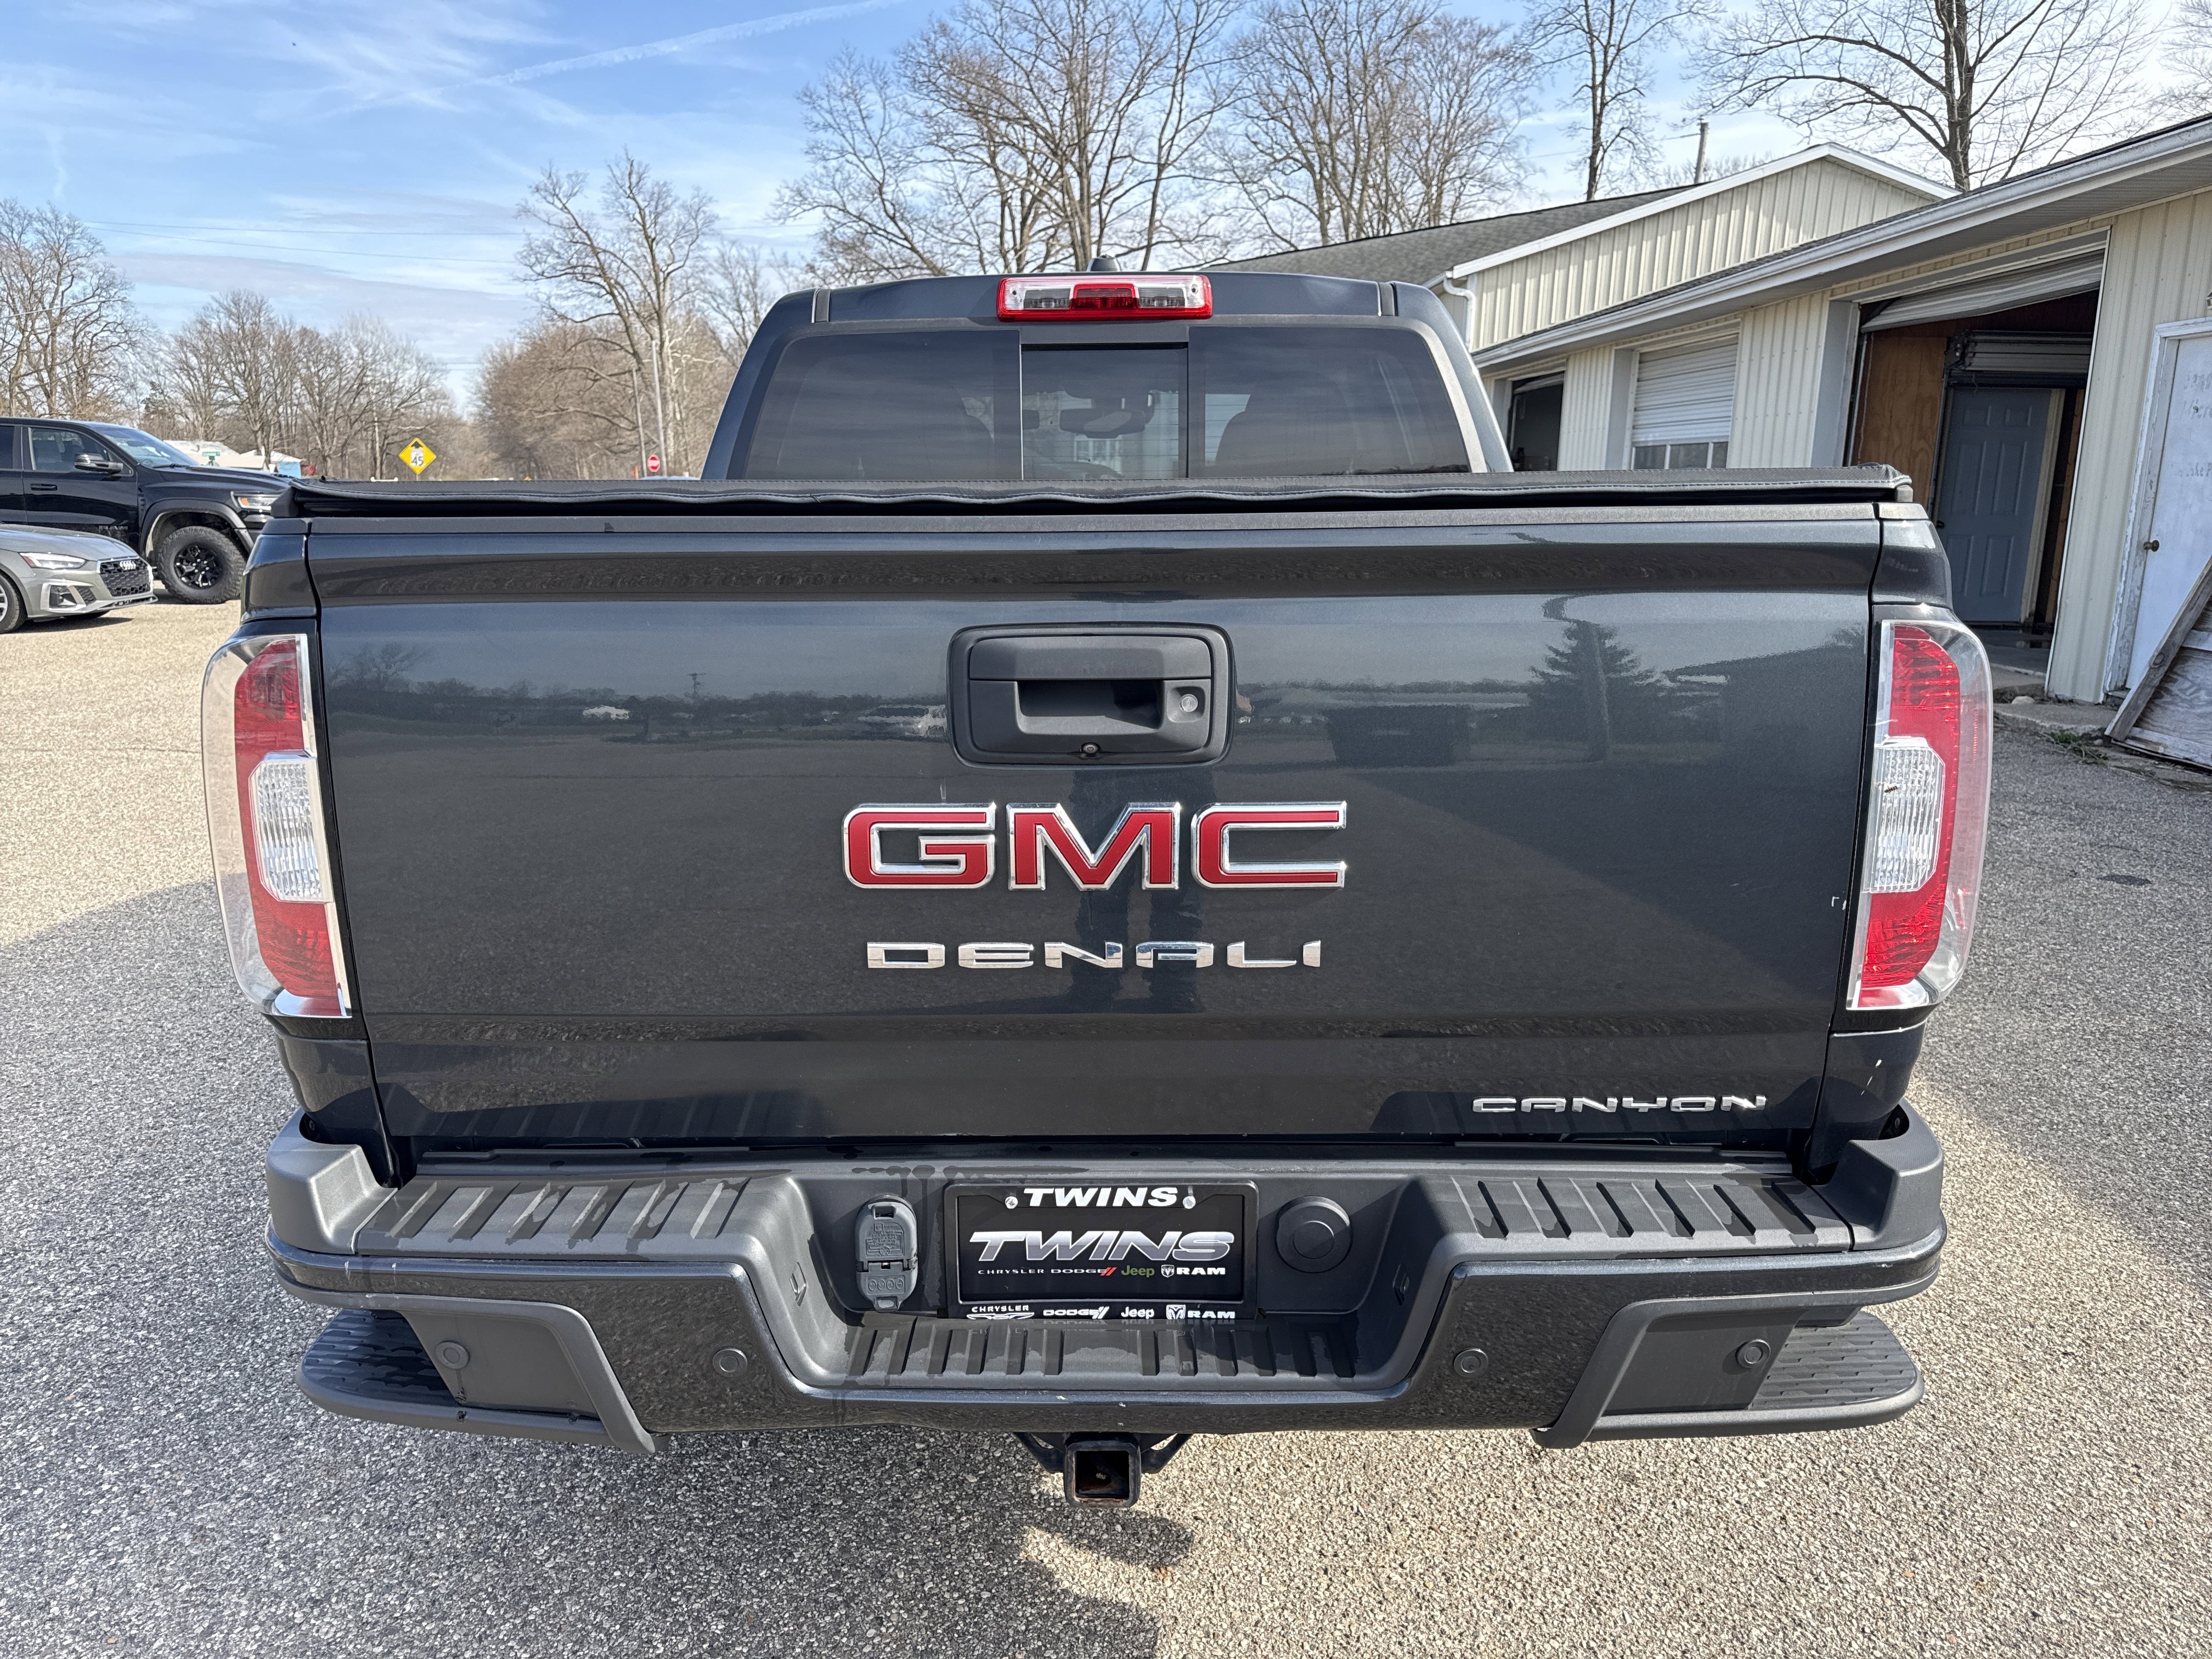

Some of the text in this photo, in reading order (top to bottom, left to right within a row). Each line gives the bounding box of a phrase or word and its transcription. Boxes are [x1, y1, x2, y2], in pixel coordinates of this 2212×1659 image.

[411, 456, 424, 466] 45
[842, 801, 1347, 890] GMC
[867, 941, 1321, 969] DENALI
[1472, 1095, 1766, 1112] CANYON
[1024, 1187, 1178, 1207] TWINS
[969, 1231, 1235, 1261] TWINS
[1121, 1265, 1155, 1278] Jeep
[972, 1305, 1029, 1313] CHRYSLER
[1121, 1306, 1155, 1319] Jeep
[1187, 1310, 1235, 1319] RAM
